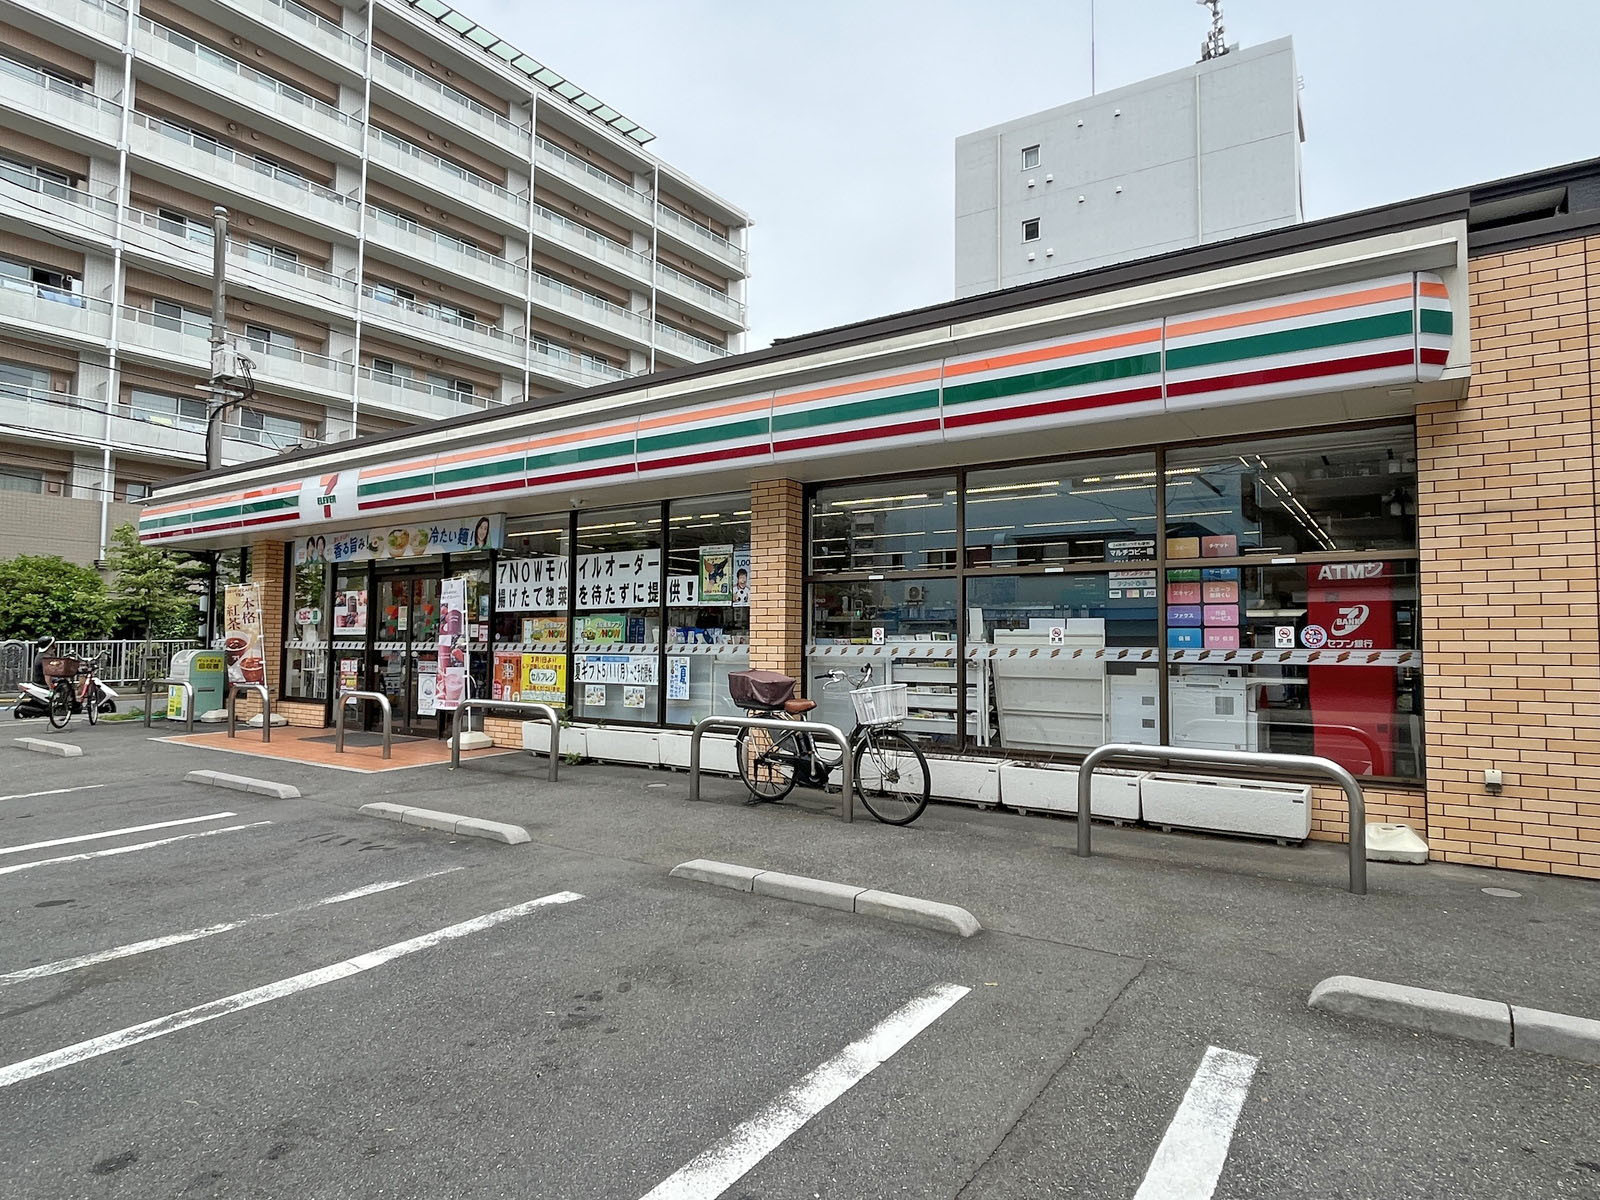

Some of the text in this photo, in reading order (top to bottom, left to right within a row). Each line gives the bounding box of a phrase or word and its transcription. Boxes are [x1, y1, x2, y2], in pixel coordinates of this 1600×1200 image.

[242, 597, 256, 625] 本格
[226, 603, 240, 630] 紅茶
[1336, 618, 1360, 626] BANK
[1327, 639, 1373, 648] セブン銀行
[531, 672, 555, 682] セルフレジ
